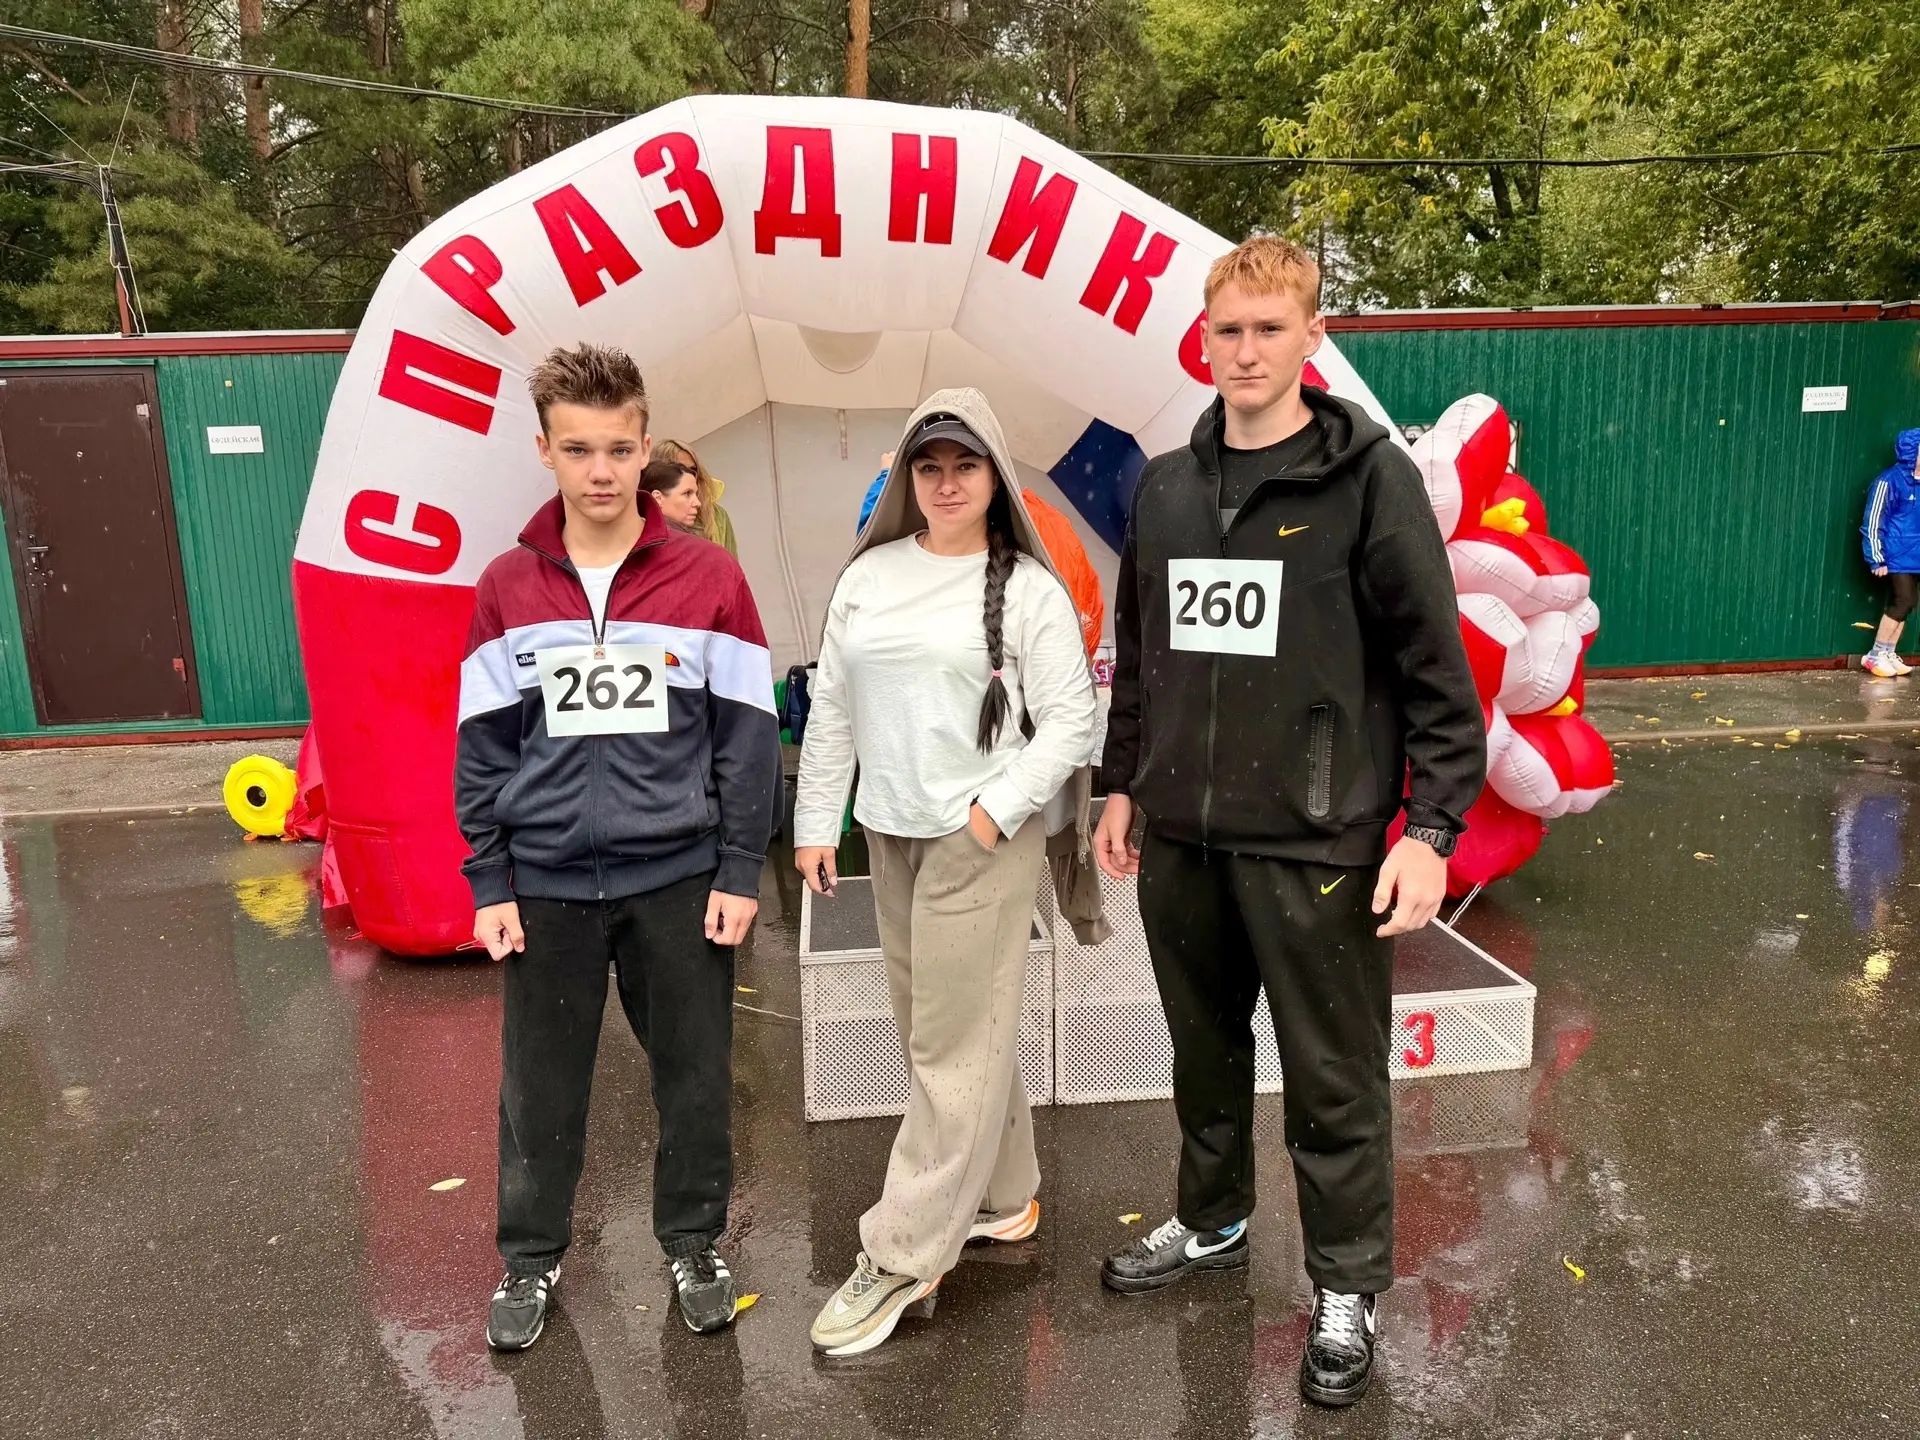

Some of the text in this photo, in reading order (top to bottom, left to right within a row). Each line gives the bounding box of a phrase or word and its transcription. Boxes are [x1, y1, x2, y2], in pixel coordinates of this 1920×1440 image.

[344, 125, 1330, 575] С ПРАЗДНИК
[1176, 580, 1266, 629] 260
[518, 654, 537, 664] elles
[553, 664, 655, 712] 262
[1403, 1010, 1436, 1069] 3
